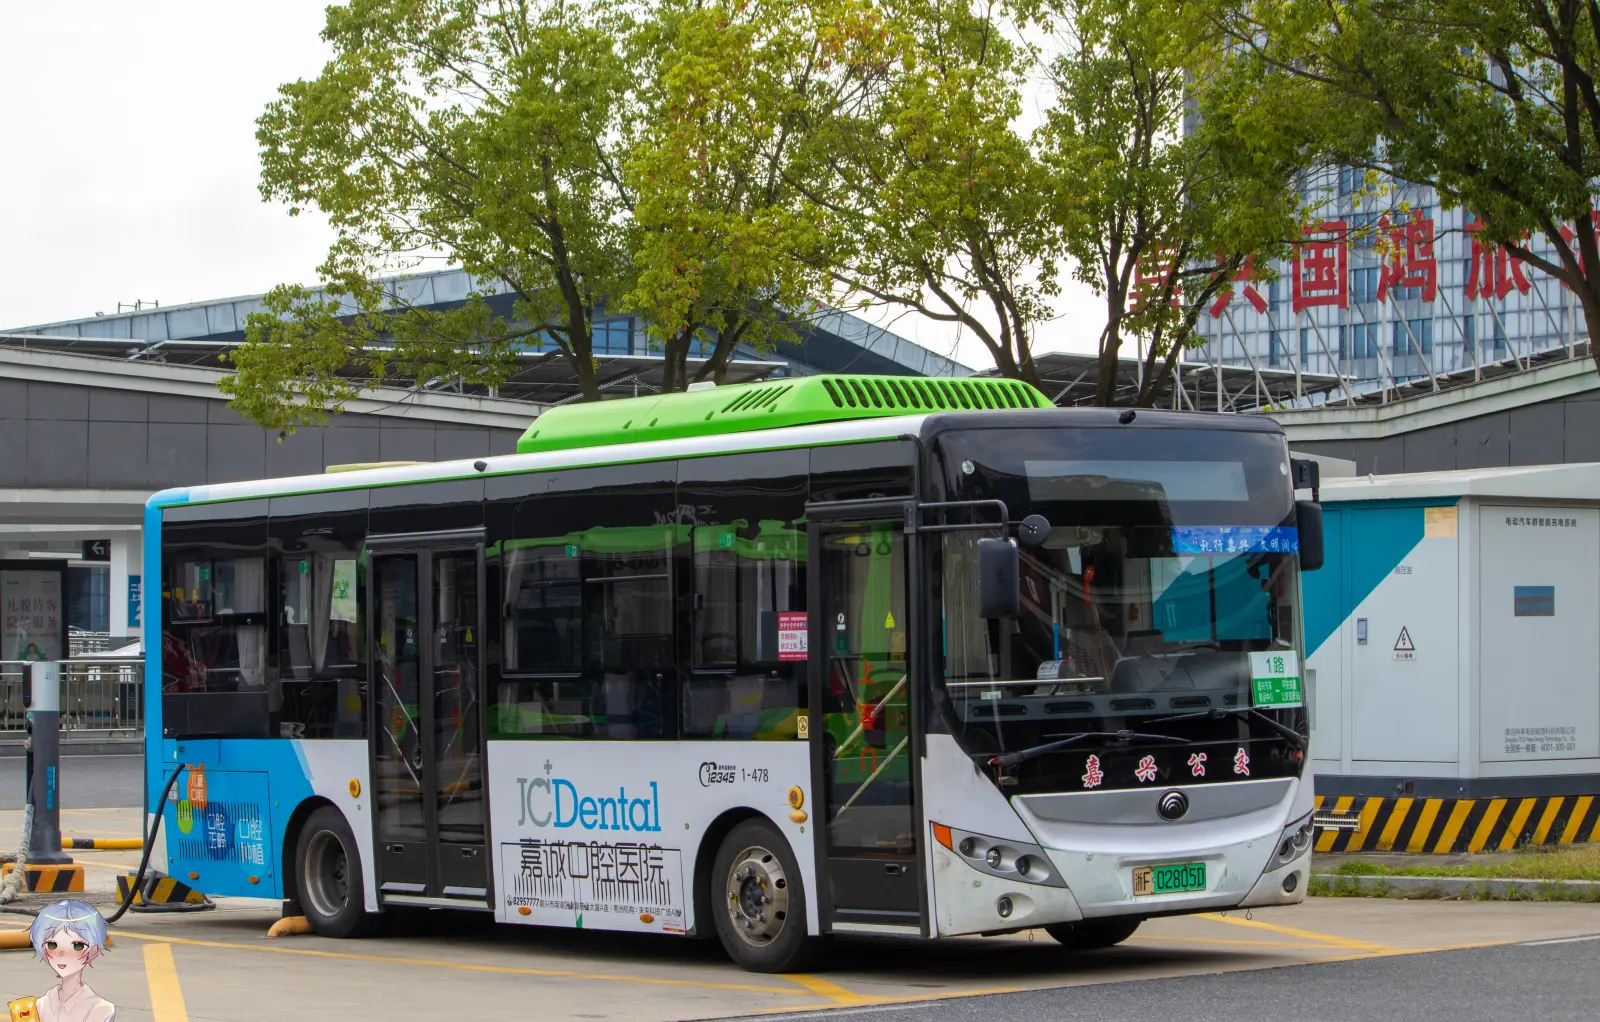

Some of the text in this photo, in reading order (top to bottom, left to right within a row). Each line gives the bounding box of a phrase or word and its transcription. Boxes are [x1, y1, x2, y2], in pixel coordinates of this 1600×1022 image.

[1505, 517, 1577, 528] 电动汽车群智能充电系统
[1266, 656, 1285, 674] 1路
[741, 768, 769, 782] 1-478
[1081, 747, 1251, 788] 嘉兴公交
[707, 772, 736, 784] 12345
[190, 788, 204, 802] 口腔
[207, 813, 225, 831] 口腔
[239, 817, 264, 841] 口腔
[519, 837, 665, 886] 嘉诚口腔医院
